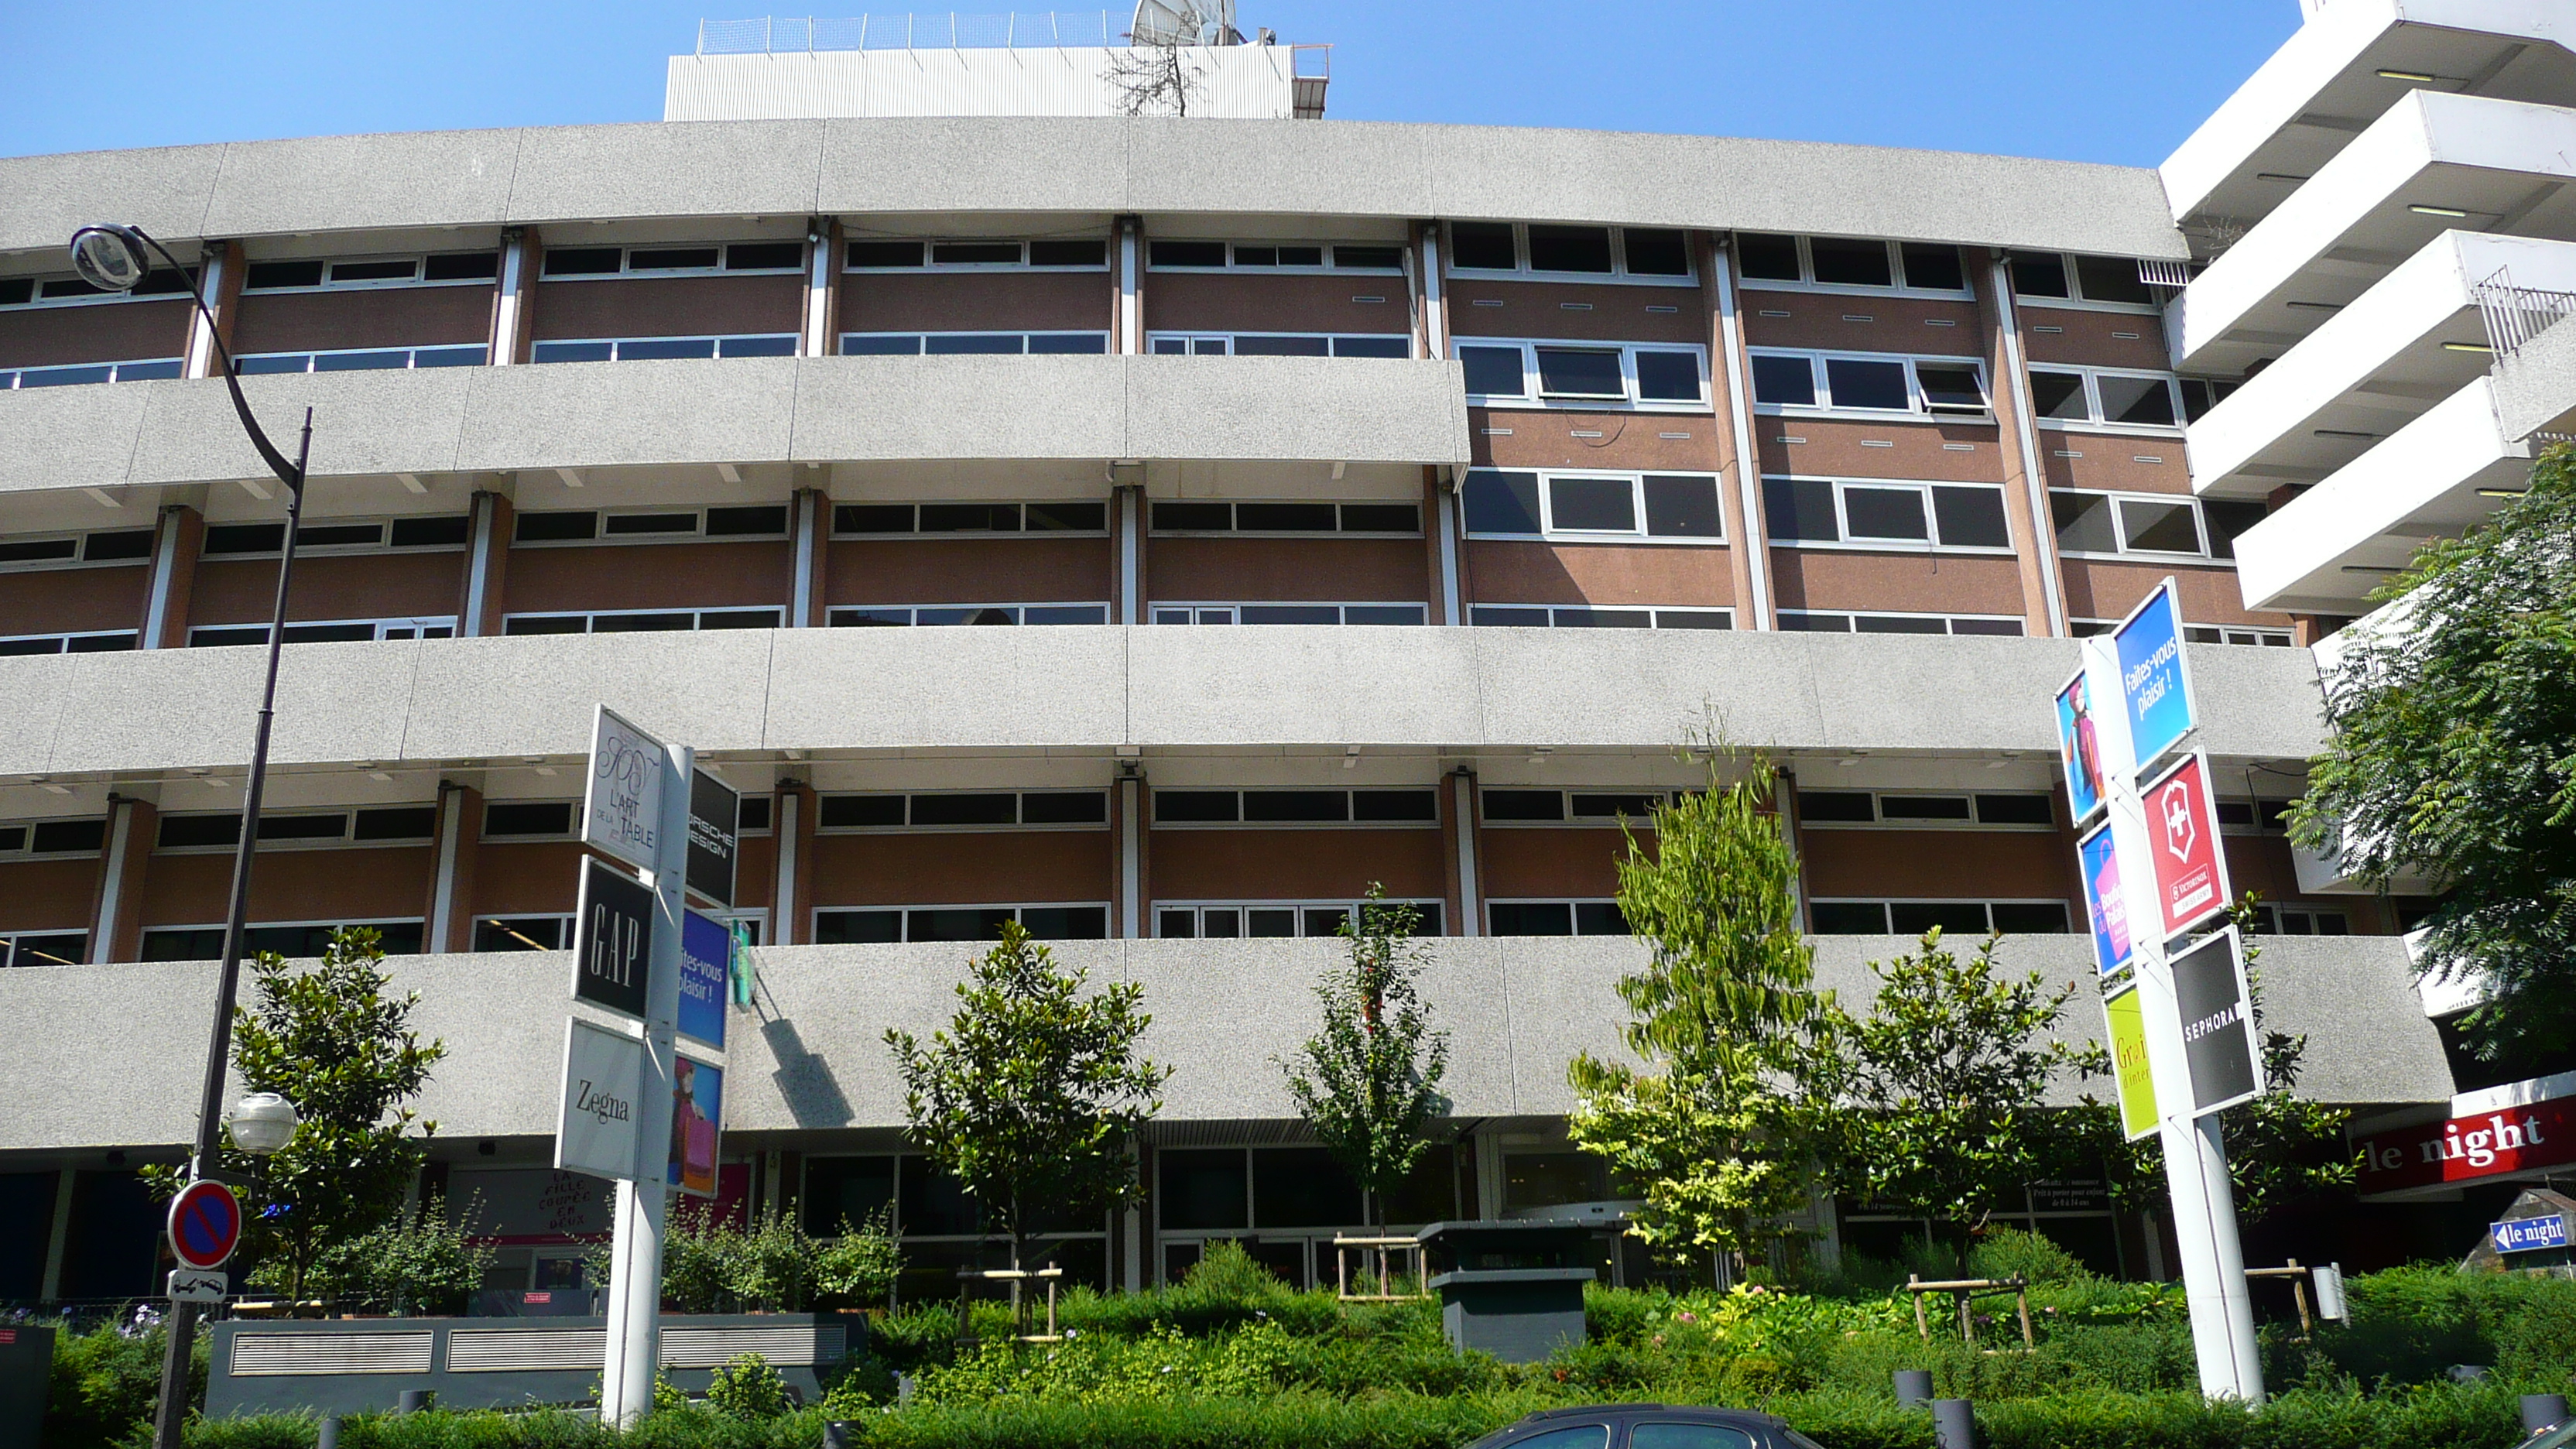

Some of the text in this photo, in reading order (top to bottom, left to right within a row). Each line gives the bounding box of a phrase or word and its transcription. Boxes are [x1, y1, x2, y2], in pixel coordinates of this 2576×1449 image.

[2125, 635, 2177, 695] Faites-vous
[2137, 674, 2165, 721] plaisir
[597, 808, 614, 825] DE LA
[610, 788, 640, 819] L'ART
[620, 817, 654, 849] TABLE
[689, 814, 735, 847] ORSCHE
[690, 830, 727, 858] ESIGN
[2100, 882, 2124, 911] Boutiq
[2105, 902, 2126, 930] Palais
[591, 903, 639, 988] GAP
[2184, 1006, 2235, 1043] SEPHORA
[2116, 1033, 2147, 1069] Grai
[576, 1079, 630, 1125] Zegna
[2363, 1115, 2545, 1173] le night
[545, 1180, 584, 1195] FILLE
[553, 1170, 571, 1183] LA
[550, 1214, 584, 1229] DEUX
[557, 1205, 575, 1218] EN
[2506, 1218, 2564, 1246] le night
